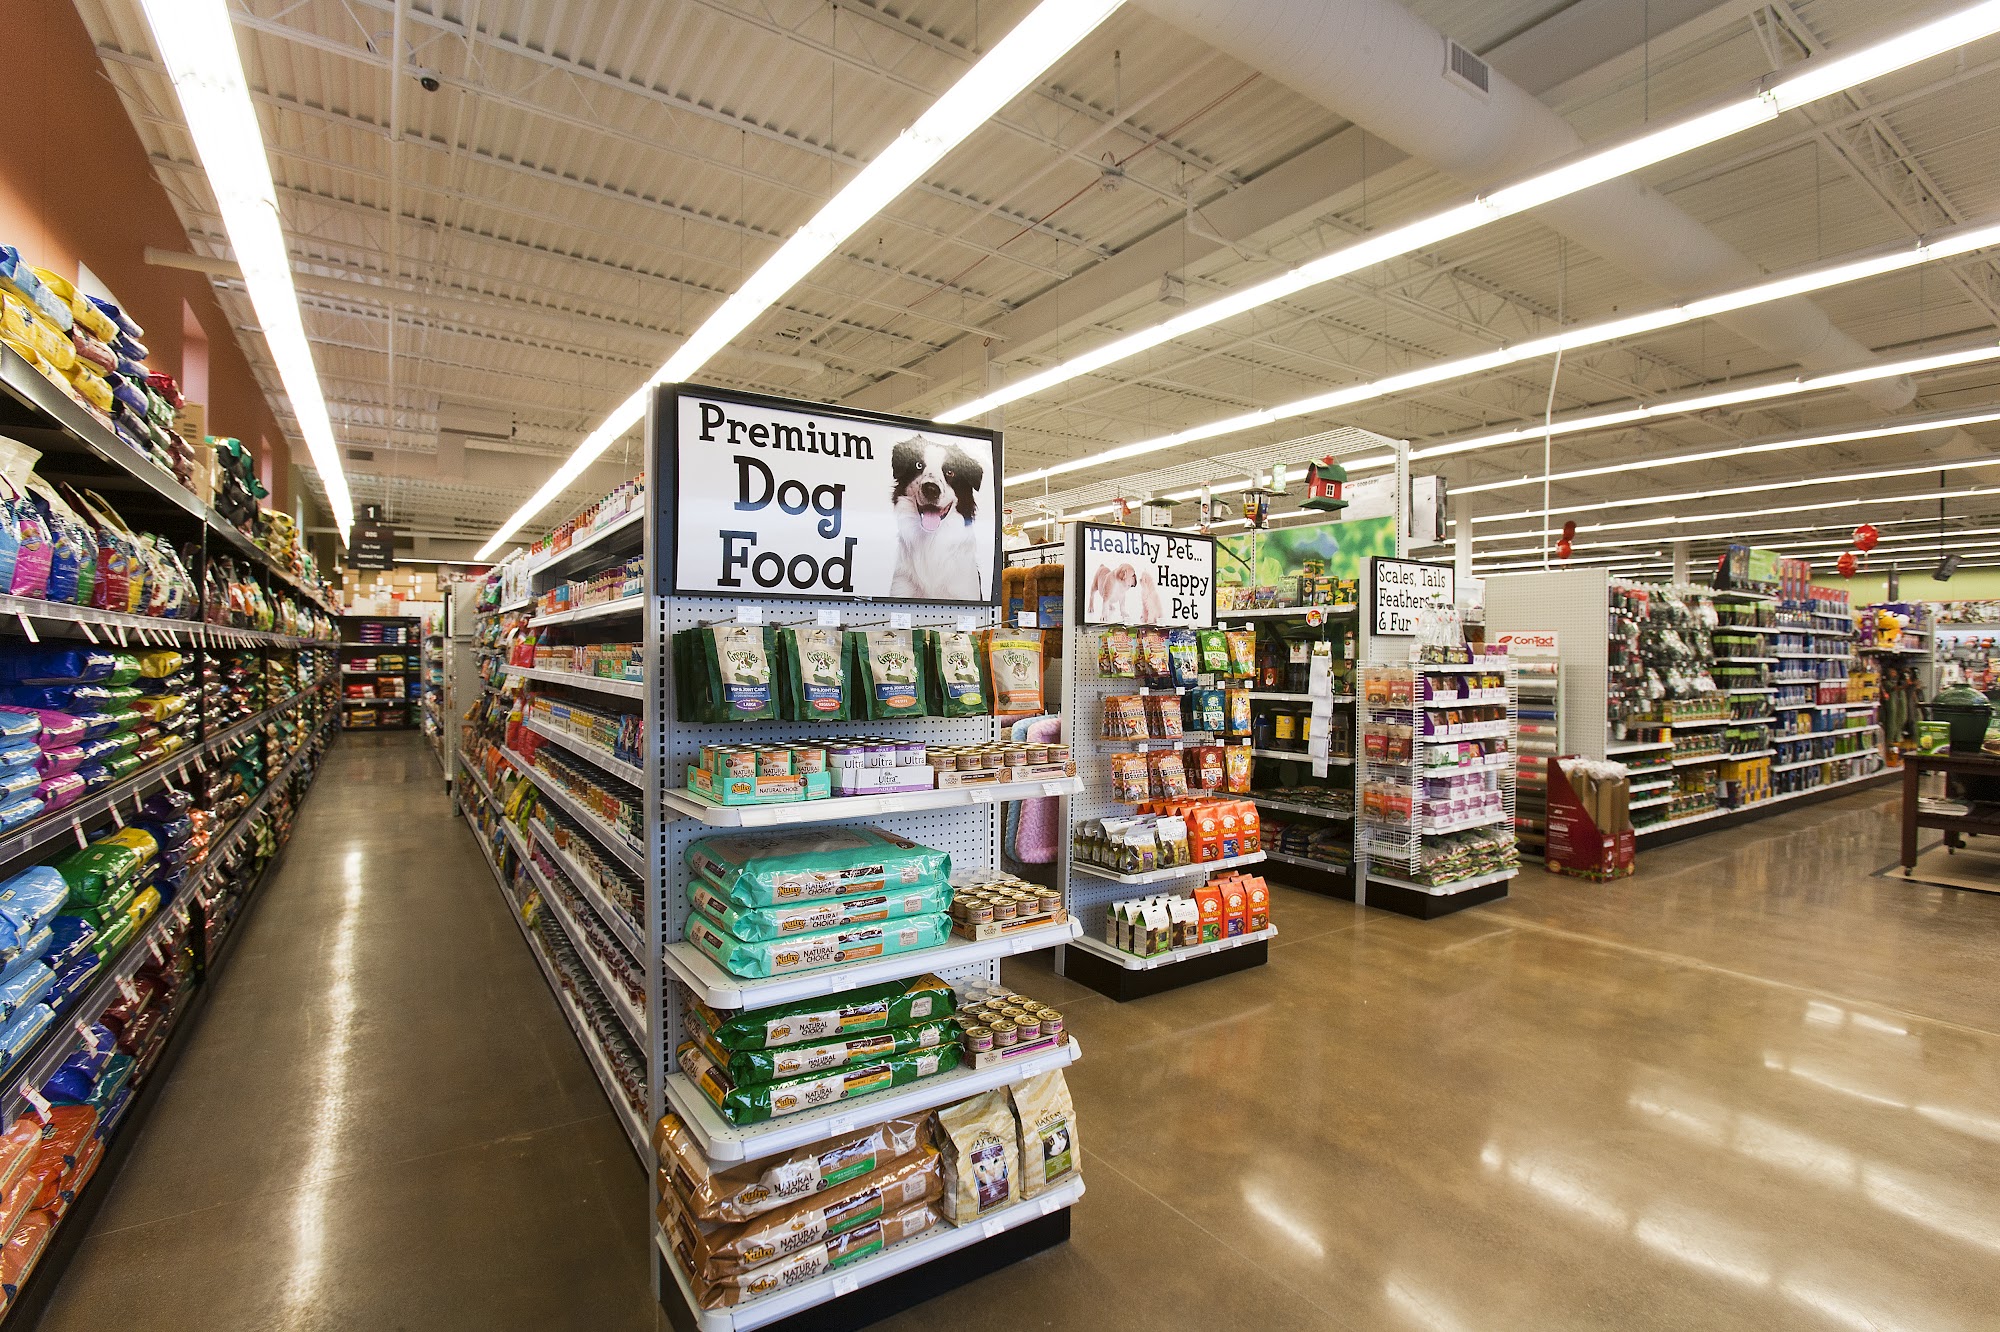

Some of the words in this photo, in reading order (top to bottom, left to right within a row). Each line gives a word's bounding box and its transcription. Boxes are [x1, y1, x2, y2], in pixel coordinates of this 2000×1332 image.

[699, 402, 874, 460] Premium
[733, 455, 846, 539] Dog
[367, 506, 374, 518] 1
[1089, 528, 1160, 564] Healthy
[1166, 536, 1202, 562] Pet...
[717, 530, 858, 592] Food
[1158, 565, 1209, 596] Happy
[1378, 563, 1416, 587] Scales,
[1420, 568, 1446, 588] Tails
[1379, 588, 1430, 609] Feathers
[1171, 598, 1199, 620] Pet
[1378, 611, 1386, 630] &
[1390, 612, 1412, 632] Fur
[726, 650, 759, 664] Greenies
[806, 650, 836, 664] Greenies
[877, 652, 909, 665] Greenies
[1003, 654, 1032, 668] Greenies
[870, 758, 893, 767] Ultra
[878, 775, 896, 783] Ultra
[808, 887, 832, 895] CHOICE
[810, 912, 839, 922] NATURAL
[812, 920, 836, 928] CHOICE
[782, 918, 806, 931] Nutro
[804, 946, 834, 957] NATURAL
[806, 954, 830, 962] CHOICE
[776, 954, 800, 966] Nutro
[800, 1022, 828, 1031] NATURAL
[802, 1028, 824, 1036] CHOICE
[808, 1055, 836, 1064] NATURAL
[805, 1087, 833, 1099] NATURAL
[808, 1094, 830, 1103] CHOICE
[988, 1136, 1000, 1144] CAT
[774, 1172, 814, 1193] NATURAL
[778, 1183, 810, 1197] CHOICE
[780, 1226, 820, 1248] NATURAL
[784, 1236, 815, 1251] CHOICE
[783, 1258, 821, 1280] NATURAL
[786, 1269, 816, 1284] CHOICE
